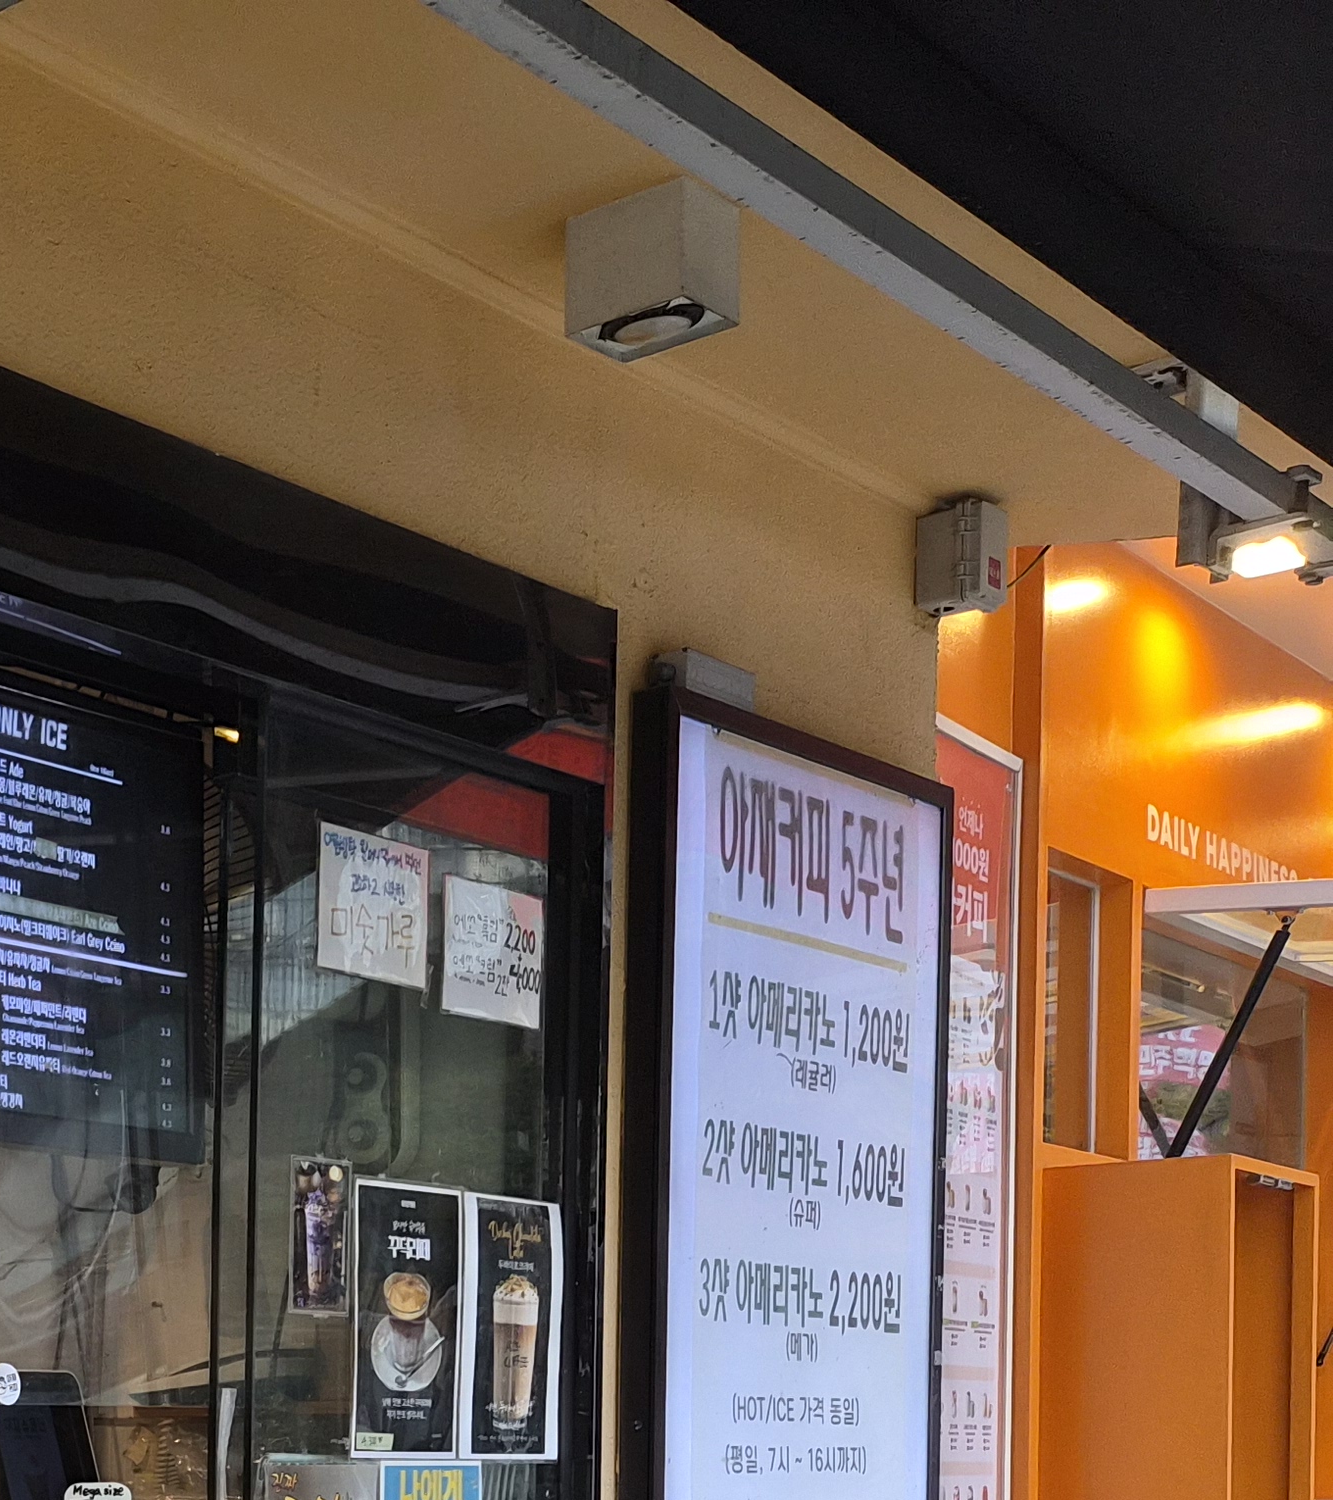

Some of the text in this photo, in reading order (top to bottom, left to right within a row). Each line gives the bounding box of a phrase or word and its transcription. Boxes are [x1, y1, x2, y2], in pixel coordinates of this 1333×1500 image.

[40, 718, 68, 750] ICE
[958, 805, 984, 841] 언제나
[1147, 803, 1201, 860] DAILY
[719, 765, 905, 945] 아재커피 5주년
[708, 969, 742, 1042] 1샷
[747, 973, 837, 1057] 아메리카노
[842, 999, 911, 1075] 1,200원
[790, 1056, 838, 1096] (레귤러)
[702, 1117, 906, 1209] 2샷 아메리카노 1,600원
[788, 1198, 822, 1231] (슈퍼)
[699, 1256, 731, 1324] 3샷
[735, 1258, 825, 1331] 아메리카노
[828, 1269, 903, 1338] 2,200원
[785, 1331, 819, 1364] (메가)
[732, 1395, 861, 1427] (HOT/ICE 가격 동일)
[724, 1445, 867, 1476] (평일, 7시 16시까지)
[73, 1484, 125, 1497] Mega size
